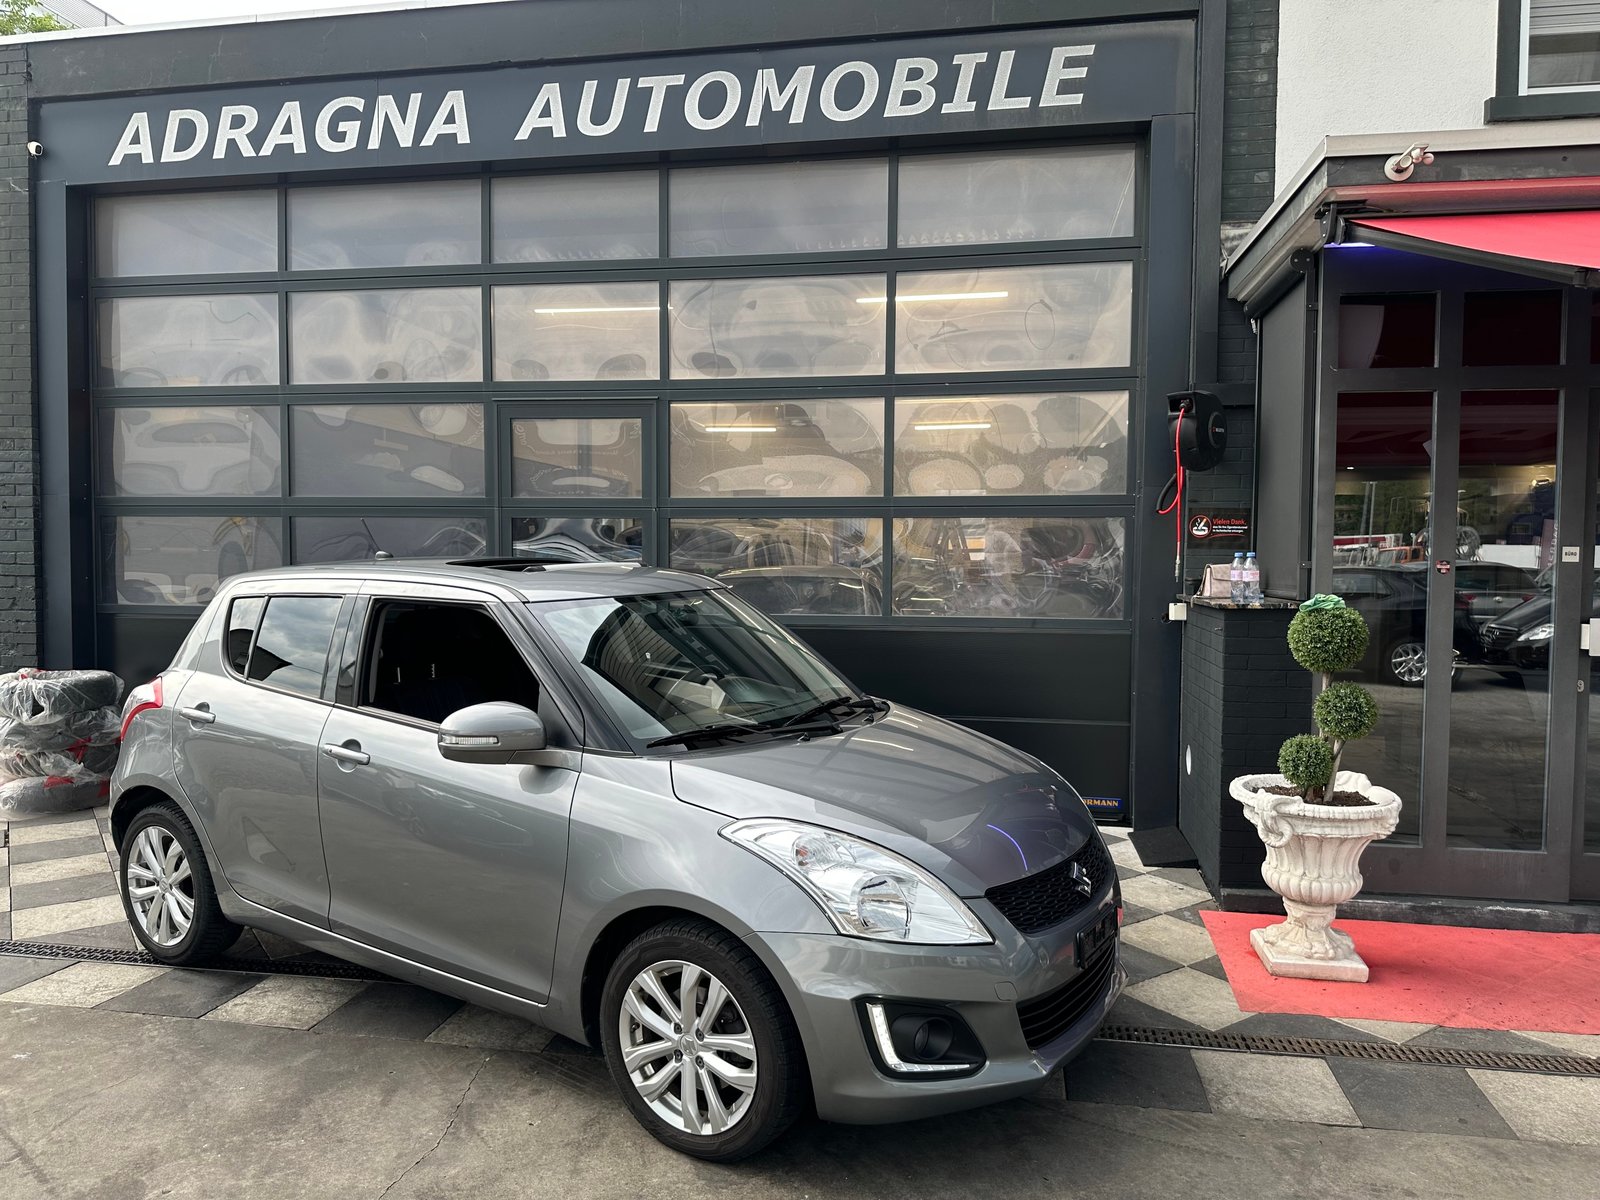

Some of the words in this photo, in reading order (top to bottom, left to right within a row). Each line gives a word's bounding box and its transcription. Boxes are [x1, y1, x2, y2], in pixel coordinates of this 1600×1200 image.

[108, 90, 471, 166] ADRAGNA
[514, 44, 1096, 141] AUTOMOBILE
[1577, 679, 1585, 693] 9
